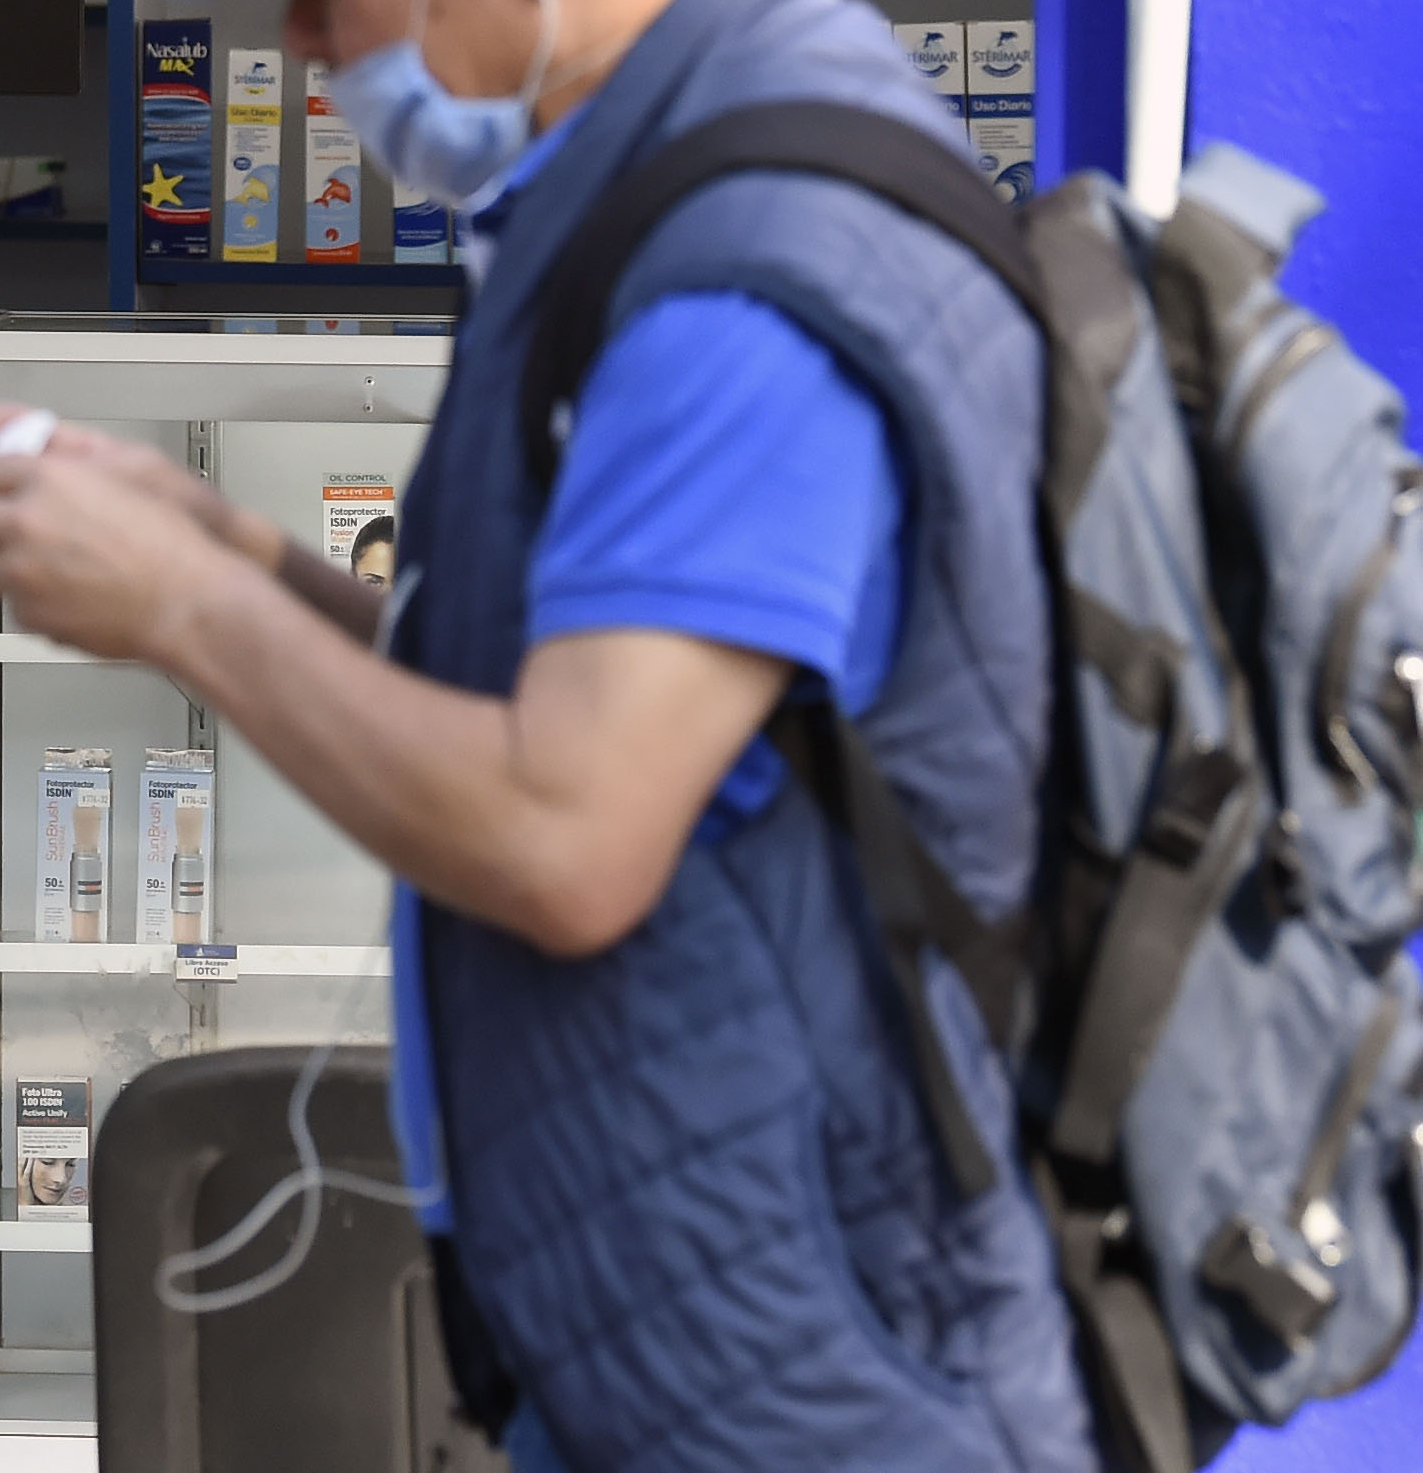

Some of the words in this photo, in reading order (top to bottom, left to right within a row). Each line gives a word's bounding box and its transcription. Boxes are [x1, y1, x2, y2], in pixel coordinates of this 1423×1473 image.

[147, 43, 207, 59] Nasalub
[46, 779, 96, 789] Fotoprotector
[46, 787, 72, 798] ISDIN
[193, 966, 220, 977] (OTC)
